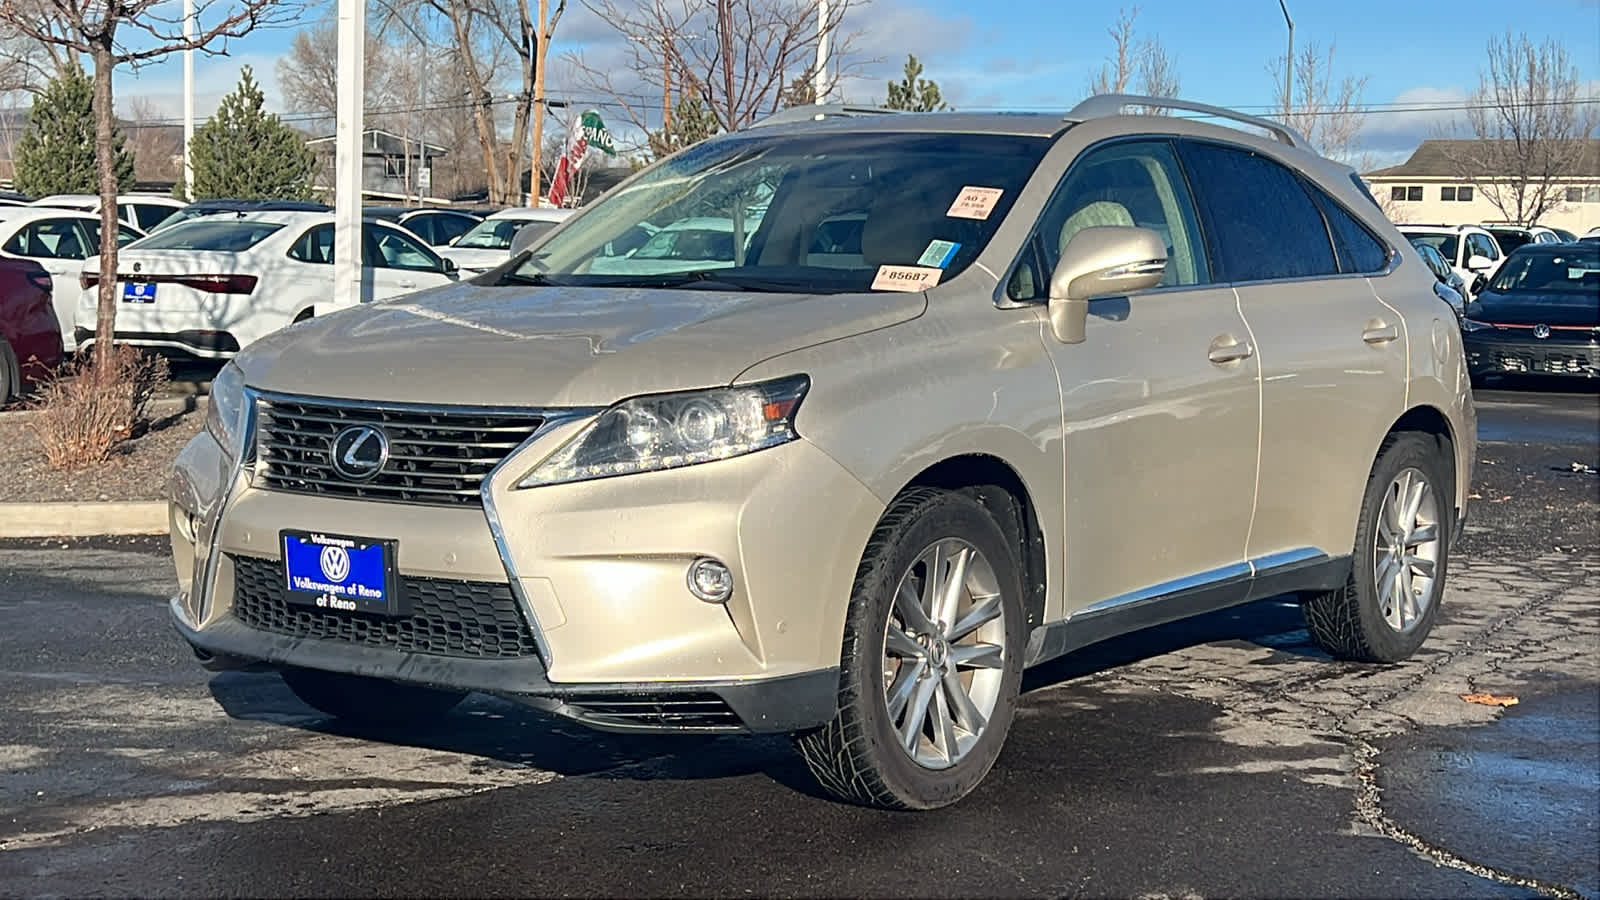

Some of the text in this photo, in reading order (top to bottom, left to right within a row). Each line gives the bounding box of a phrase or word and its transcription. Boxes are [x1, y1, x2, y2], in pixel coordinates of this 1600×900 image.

[888, 271, 929, 281] 85687
[310, 533, 355, 548] Volkswagen
[293, 576, 382, 599] Volkswagen of Reno
[316, 594, 356, 611] of Reno
